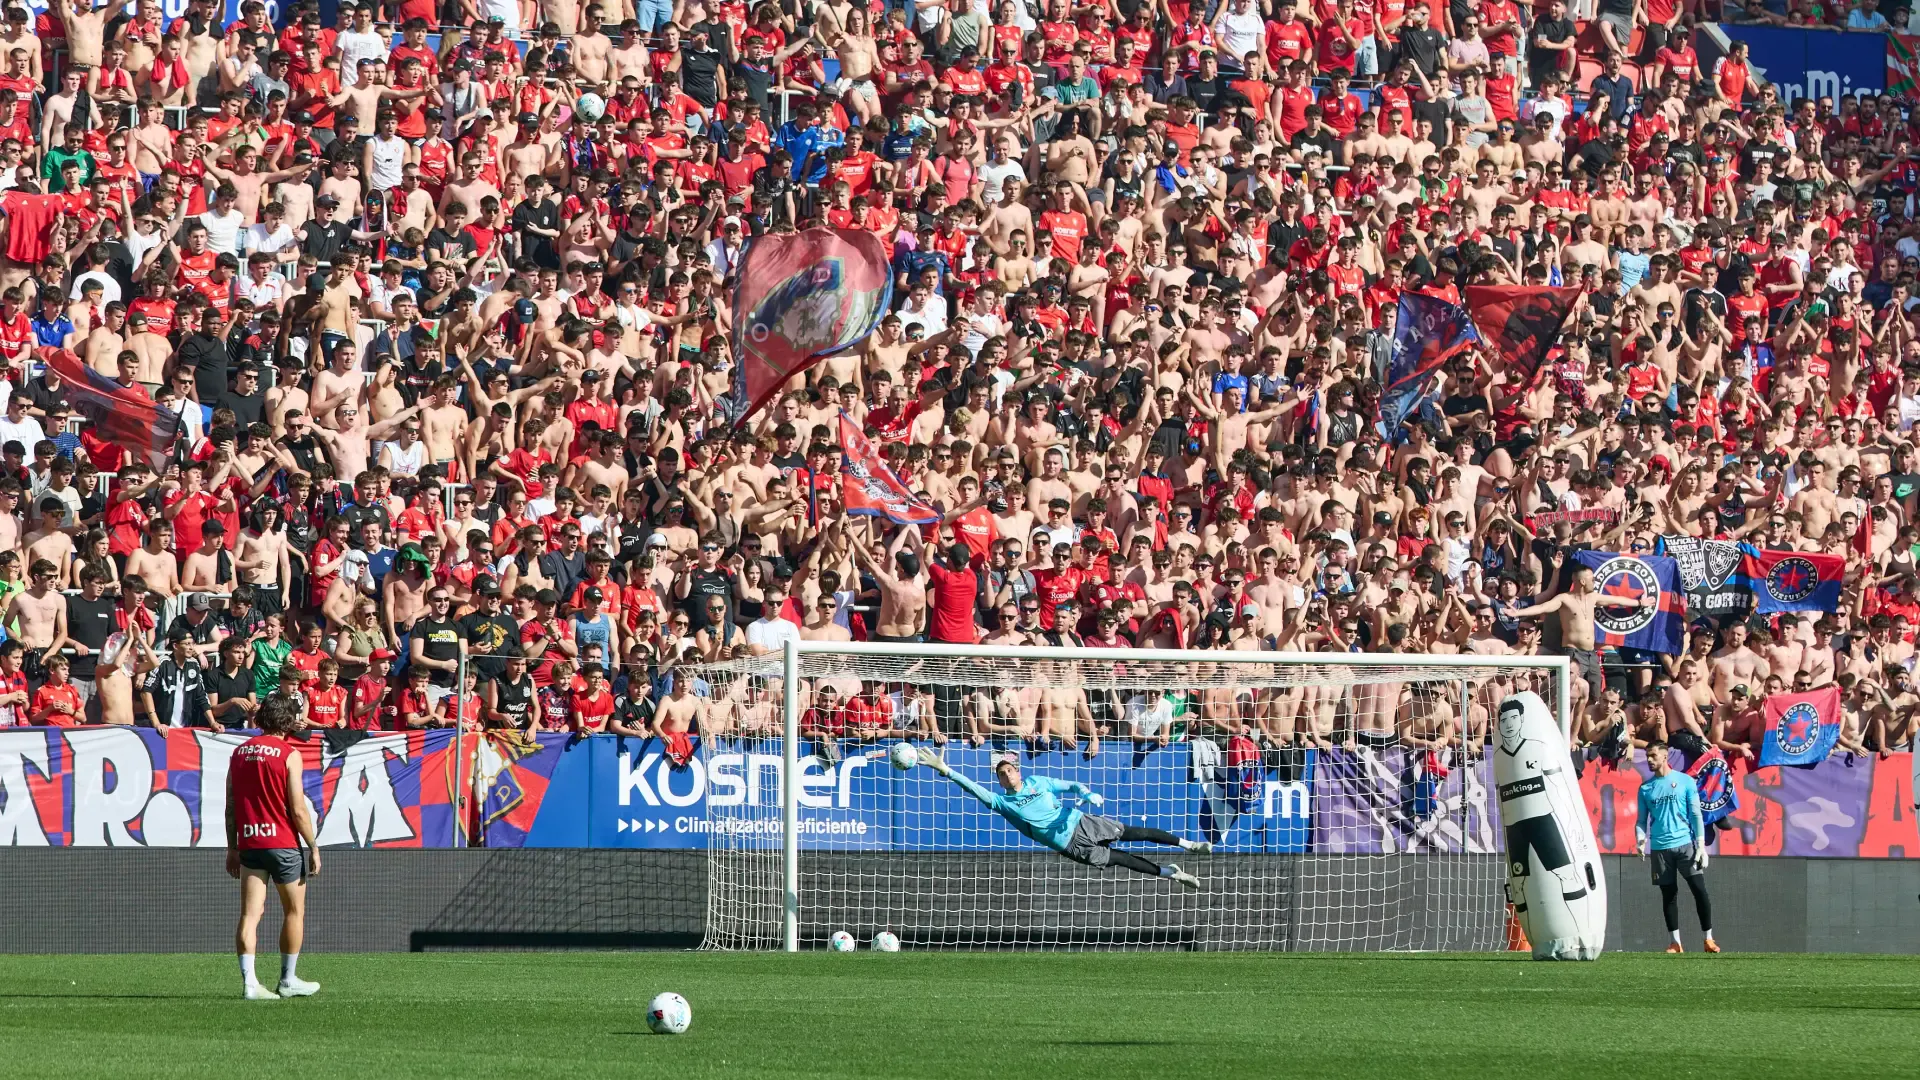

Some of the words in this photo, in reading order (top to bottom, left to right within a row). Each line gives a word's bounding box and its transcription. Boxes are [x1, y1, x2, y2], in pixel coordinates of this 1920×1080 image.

[238, 745, 281, 758] macron
[1502, 782, 1542, 797] ranking.es
[243, 822, 277, 838] DIGI
[797, 817, 867, 835] eficiente
